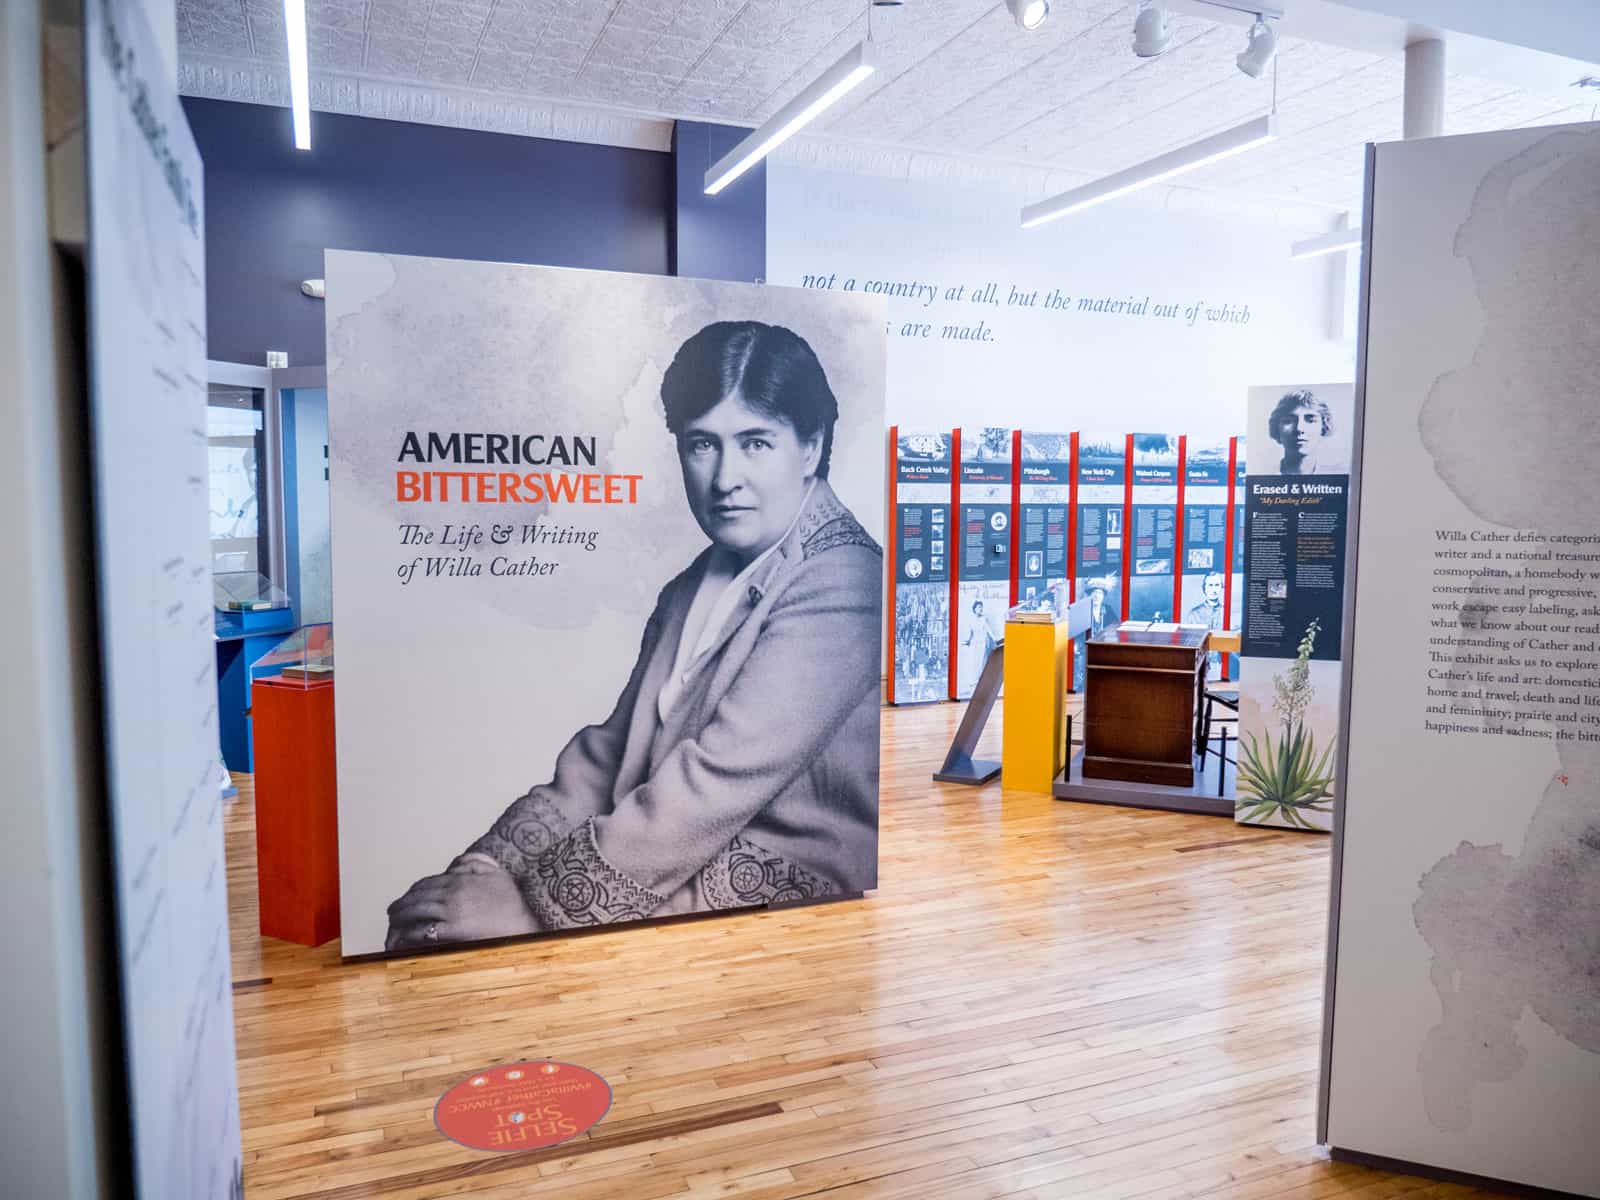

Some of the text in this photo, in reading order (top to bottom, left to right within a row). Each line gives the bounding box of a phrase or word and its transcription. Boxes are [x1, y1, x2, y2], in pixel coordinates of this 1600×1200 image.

[802, 272, 1251, 327] not a country at all, but the material out of which
[900, 321, 932, 339] are
[941, 320, 995, 343] made.
[397, 431, 597, 466] AMERICAN
[933, 465, 949, 475] Valley
[396, 471, 644, 504] BITTERSWEET
[1253, 484, 1342, 495] Erased & Written
[398, 524, 600, 552] The Life & Writing
[1435, 530, 1467, 542] Willa
[1470, 531, 1510, 543] Cather
[1513, 531, 1546, 543] defies
[1434, 549, 1468, 560] writer
[1471, 549, 1492, 560] and
[1505, 550, 1552, 561] national
[397, 556, 560, 585] of Willa Cather
[1433, 566, 1512, 579] cosmopolitan,
[1524, 568, 1585, 582] homebody
[1432, 584, 1597, 600] conservative and progressive,
[1431, 600, 1460, 611] work
[1462, 603, 1499, 615] escape
[1502, 605, 1527, 617] easy
[1529, 603, 1579, 618] labeling,
[1430, 618, 1458, 629] what
[1460, 621, 1478, 629] we
[1480, 619, 1512, 631] know
[1514, 621, 1548, 632] about
[1550, 624, 1571, 633] our
[1429, 636, 1510, 651] understanding
[1513, 638, 1527, 649] of
[1528, 638, 1569, 650] Cather
[1572, 641, 1594, 652] and
[1429, 651, 1599, 672] This exhibit asks us to explore
[1476, 671, 1495, 682] life
[1498, 673, 1519, 684] and
[1426, 686, 1600, 706] home and travel; death and life
[1425, 703, 1446, 714] and
[1449, 704, 1512, 719] femininity;
[1514, 708, 1552, 722] prairie
[1555, 712, 1578, 723] and
[1424, 720, 1479, 734] happiness
[1482, 724, 1503, 735] and
[1506, 727, 1552, 740] sadness;
[1555, 729, 1576, 741] the
[488, 1117, 577, 1146] SELFIE
